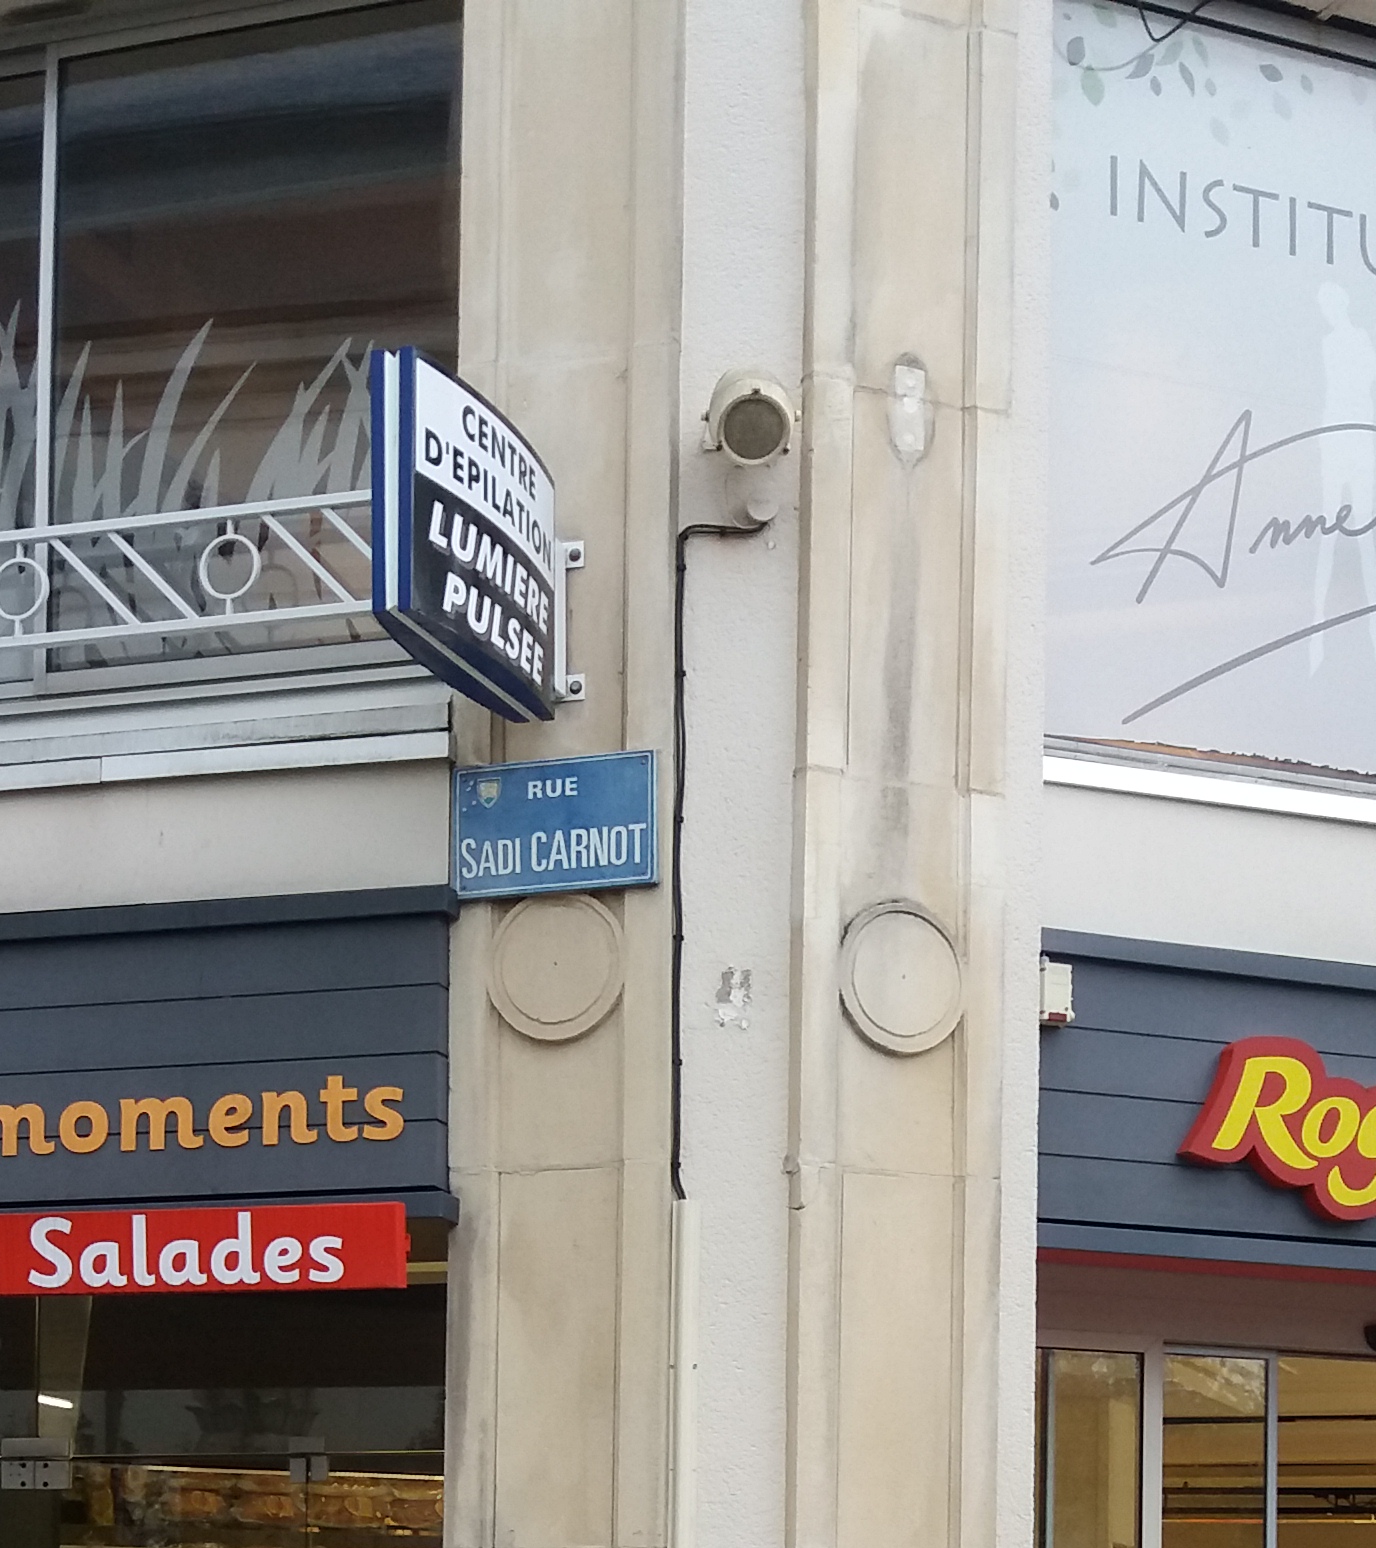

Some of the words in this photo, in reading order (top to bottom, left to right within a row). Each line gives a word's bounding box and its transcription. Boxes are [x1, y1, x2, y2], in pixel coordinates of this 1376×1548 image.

[424, 427, 553, 572] D'EPILATION
[461, 405, 536, 500] CENTRE
[428, 500, 548, 635] LUMIERE
[442, 571, 544, 685] PULSEE
[527, 776, 578, 800] RUE
[461, 837, 522, 879] SADI
[531, 823, 647, 873] CARNOT
[27, 1210, 346, 1291] Salades
